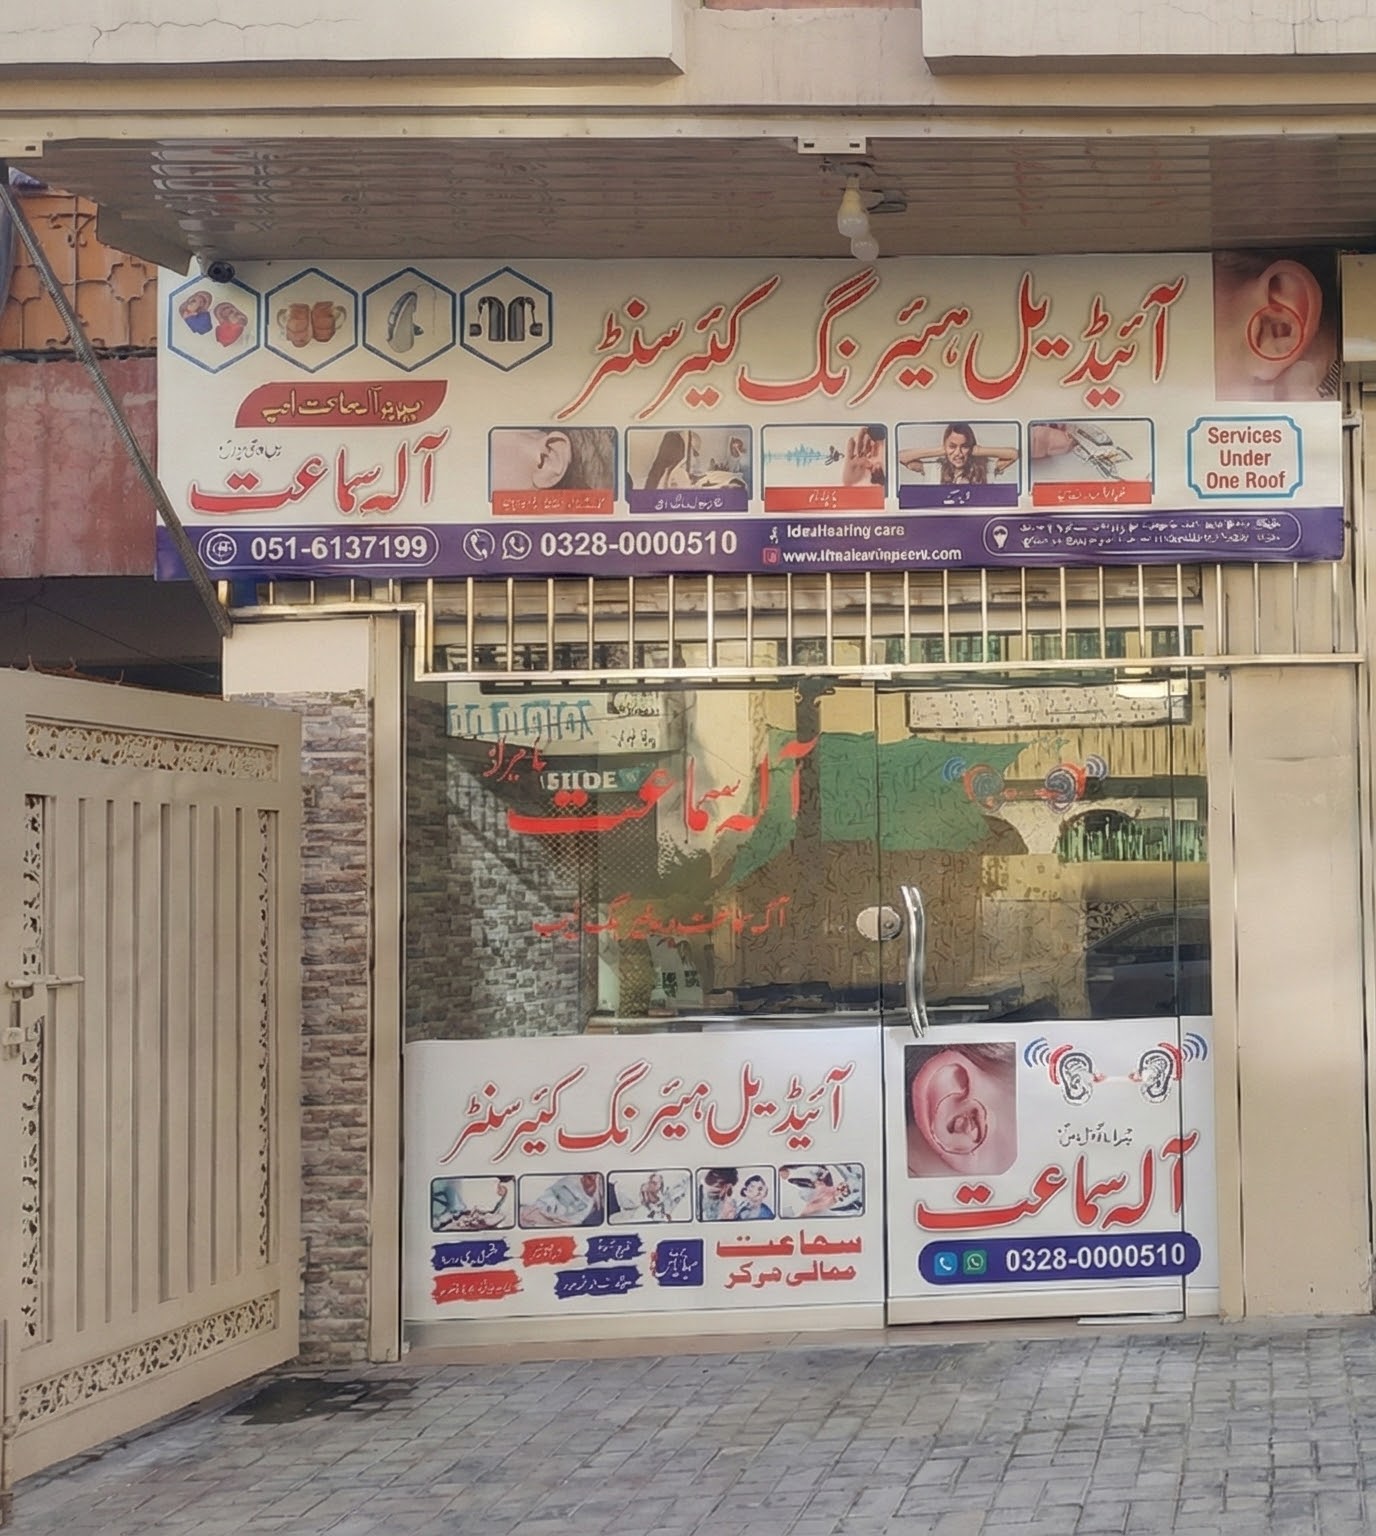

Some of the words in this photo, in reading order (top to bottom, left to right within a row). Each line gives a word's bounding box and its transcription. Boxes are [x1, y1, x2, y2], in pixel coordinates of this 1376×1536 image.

[1208, 426, 1282, 444] Services
[1220, 449, 1271, 466] Under
[1206, 472, 1239, 489] One
[1246, 471, 1285, 488] Roof
[251, 535, 428, 560] 051-6137199
[540, 530, 738, 556] 0328-0000510
[1005, 1242, 1186, 1272] 0328-0000510
